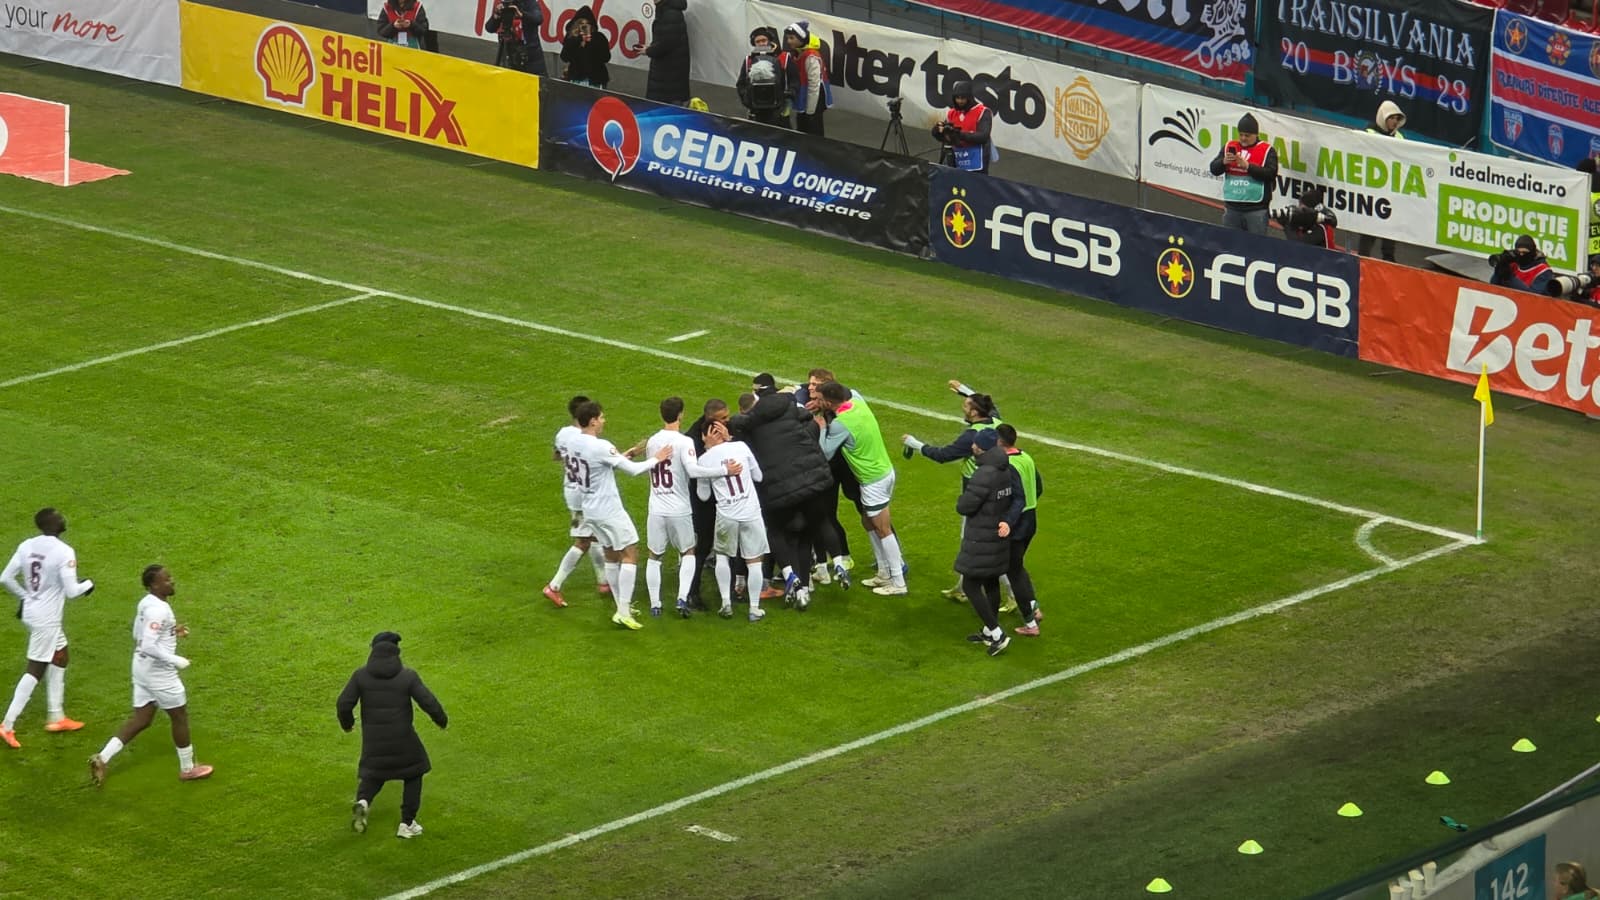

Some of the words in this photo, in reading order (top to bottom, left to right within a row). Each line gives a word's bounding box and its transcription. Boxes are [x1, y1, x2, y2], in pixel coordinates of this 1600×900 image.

[5, 3, 48, 28] your
[52, 12, 124, 42] more
[321, 34, 382, 77] Shell
[1281, 37, 1309, 74] 20
[1436, 74, 1468, 115] 23
[320, 68, 467, 147] HELIX
[647, 161, 755, 195] Publicitate
[761, 185, 782, 200] în
[652, 124, 796, 185] CEDRU
[792, 171, 877, 203] CONCEPT
[1316, 146, 1427, 199] MEDIA
[1449, 152, 1567, 198] idealmedia.ro
[1446, 286, 1600, 408] Bet
[1490, 862, 1529, 900] 142
